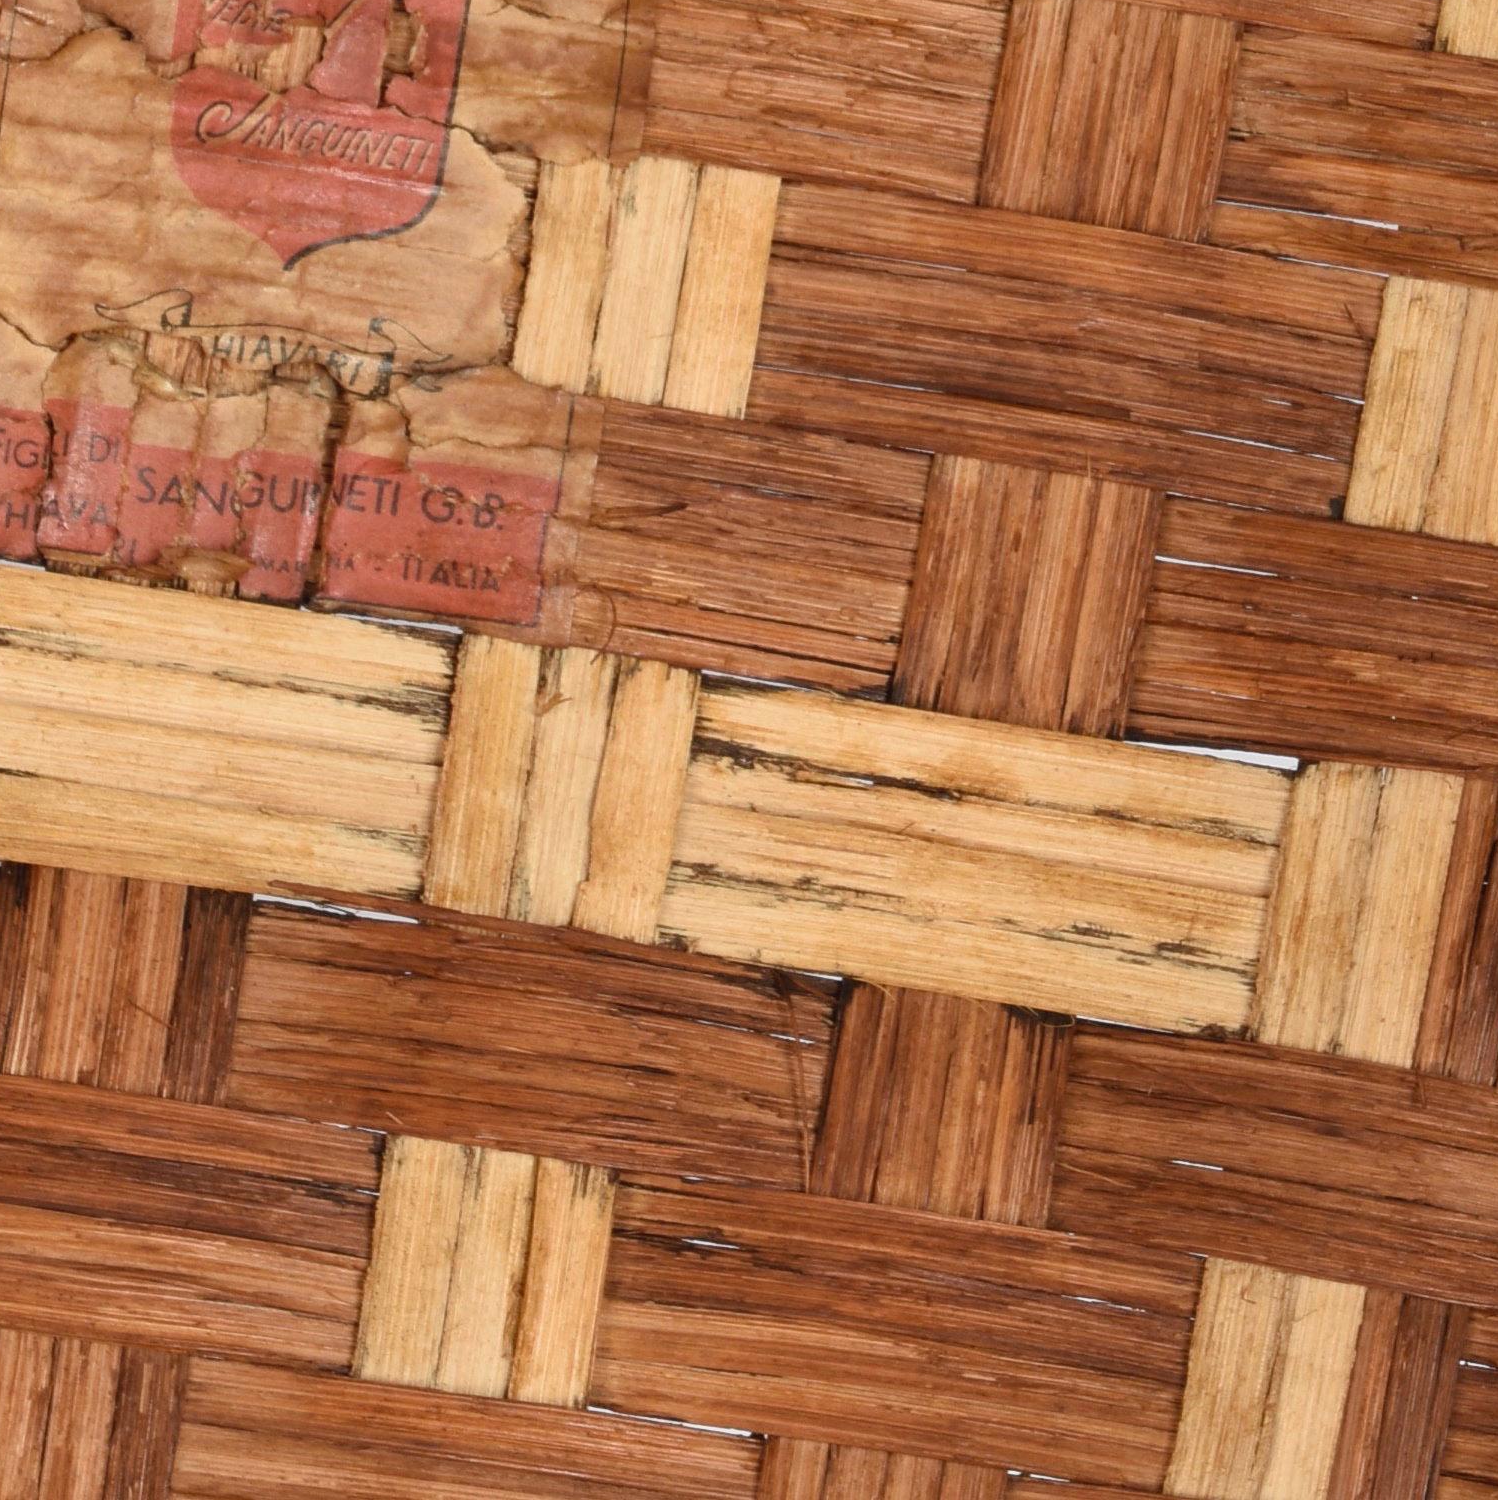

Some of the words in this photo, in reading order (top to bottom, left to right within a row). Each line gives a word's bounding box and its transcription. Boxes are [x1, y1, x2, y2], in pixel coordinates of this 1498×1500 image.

[192, 334, 364, 386] HIAVARI
[88, 433, 119, 464] DI
[135, 466, 400, 517] SANGUINETI
[420, 485, 506, 531] G.B.
[401, 552, 500, 593] ITALIA
